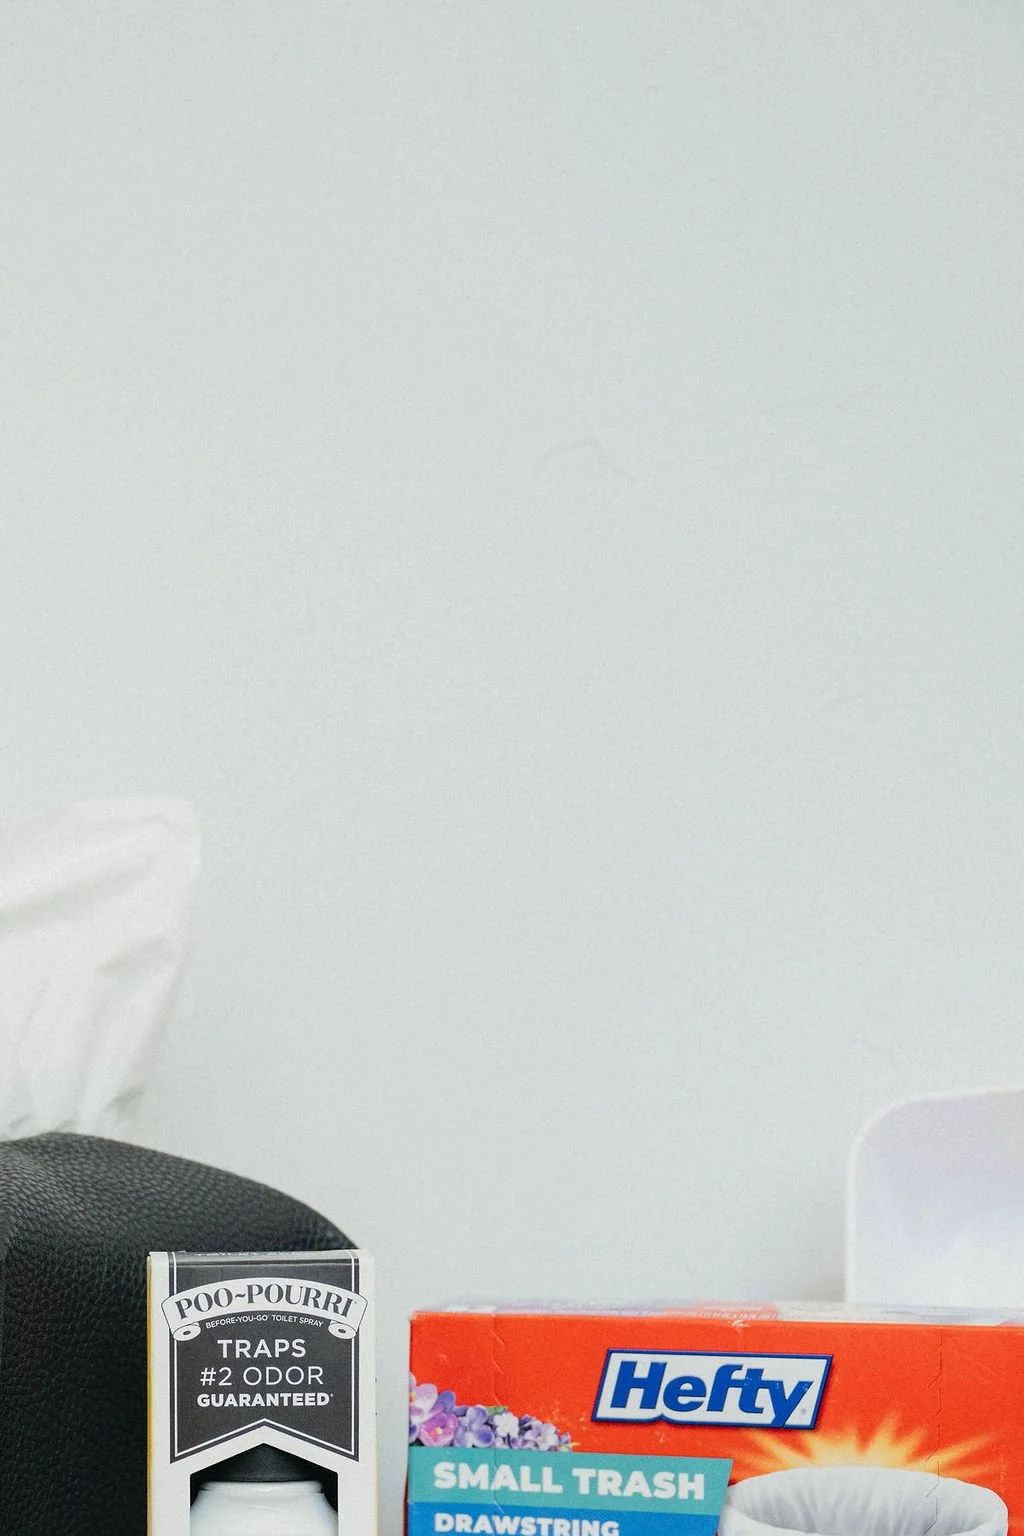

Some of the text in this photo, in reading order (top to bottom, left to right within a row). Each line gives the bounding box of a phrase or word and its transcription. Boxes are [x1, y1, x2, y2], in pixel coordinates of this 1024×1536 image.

[272, 1314, 297, 1323] TOILET
[299, 1316, 324, 1328] SPRAY
[217, 1339, 306, 1358] TRAPS
[200, 1366, 324, 1386] #2 ODOR
[610, 1360, 814, 1428] Hefty
[433, 1462, 705, 1500] SMALL TRASH
